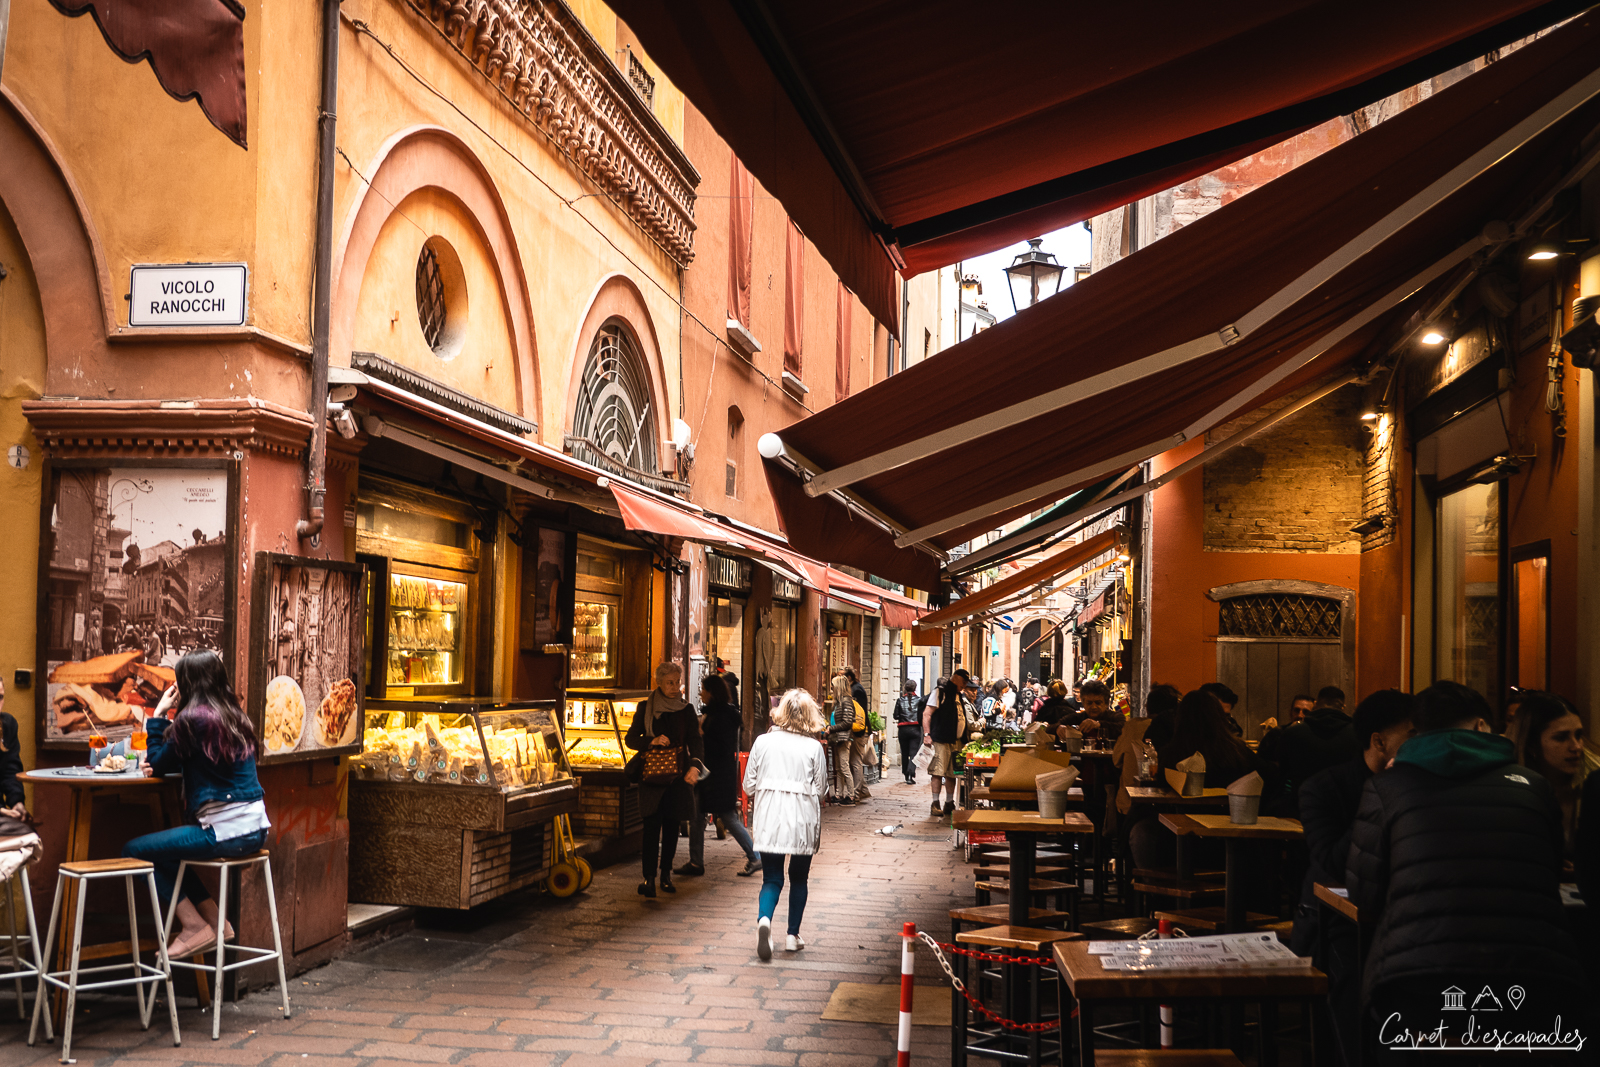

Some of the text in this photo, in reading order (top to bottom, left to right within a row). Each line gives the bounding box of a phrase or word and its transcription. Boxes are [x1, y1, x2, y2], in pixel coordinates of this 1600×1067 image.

[161, 280, 215, 295] VICOLO
[150, 298, 225, 315] RANOCCHI
[16, 457, 21, 467] A
